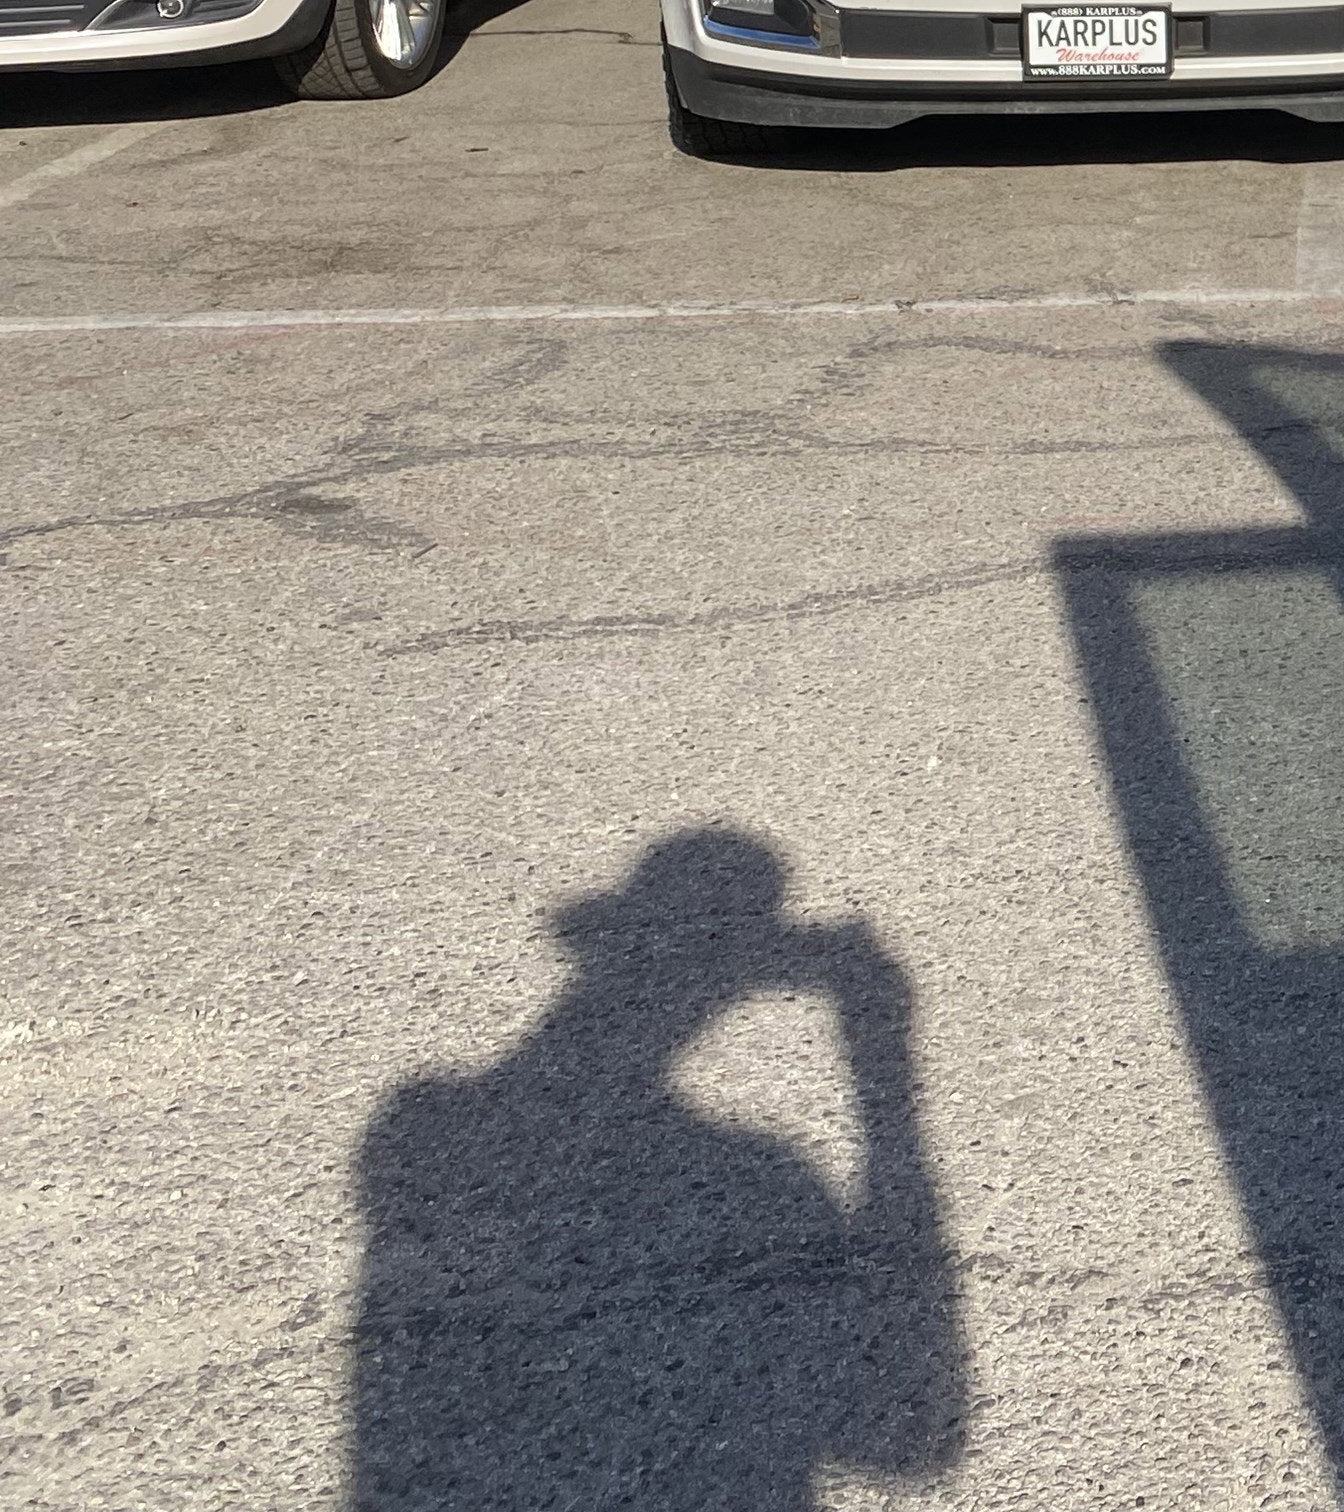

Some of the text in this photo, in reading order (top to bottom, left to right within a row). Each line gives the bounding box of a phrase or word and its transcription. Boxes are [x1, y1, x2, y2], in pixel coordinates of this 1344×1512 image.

[1057, 7, 1136, 16] (888) KARPLUS
[1037, 18, 1157, 47] KARPLUS
[1056, 47, 1140, 63] Warehouse
